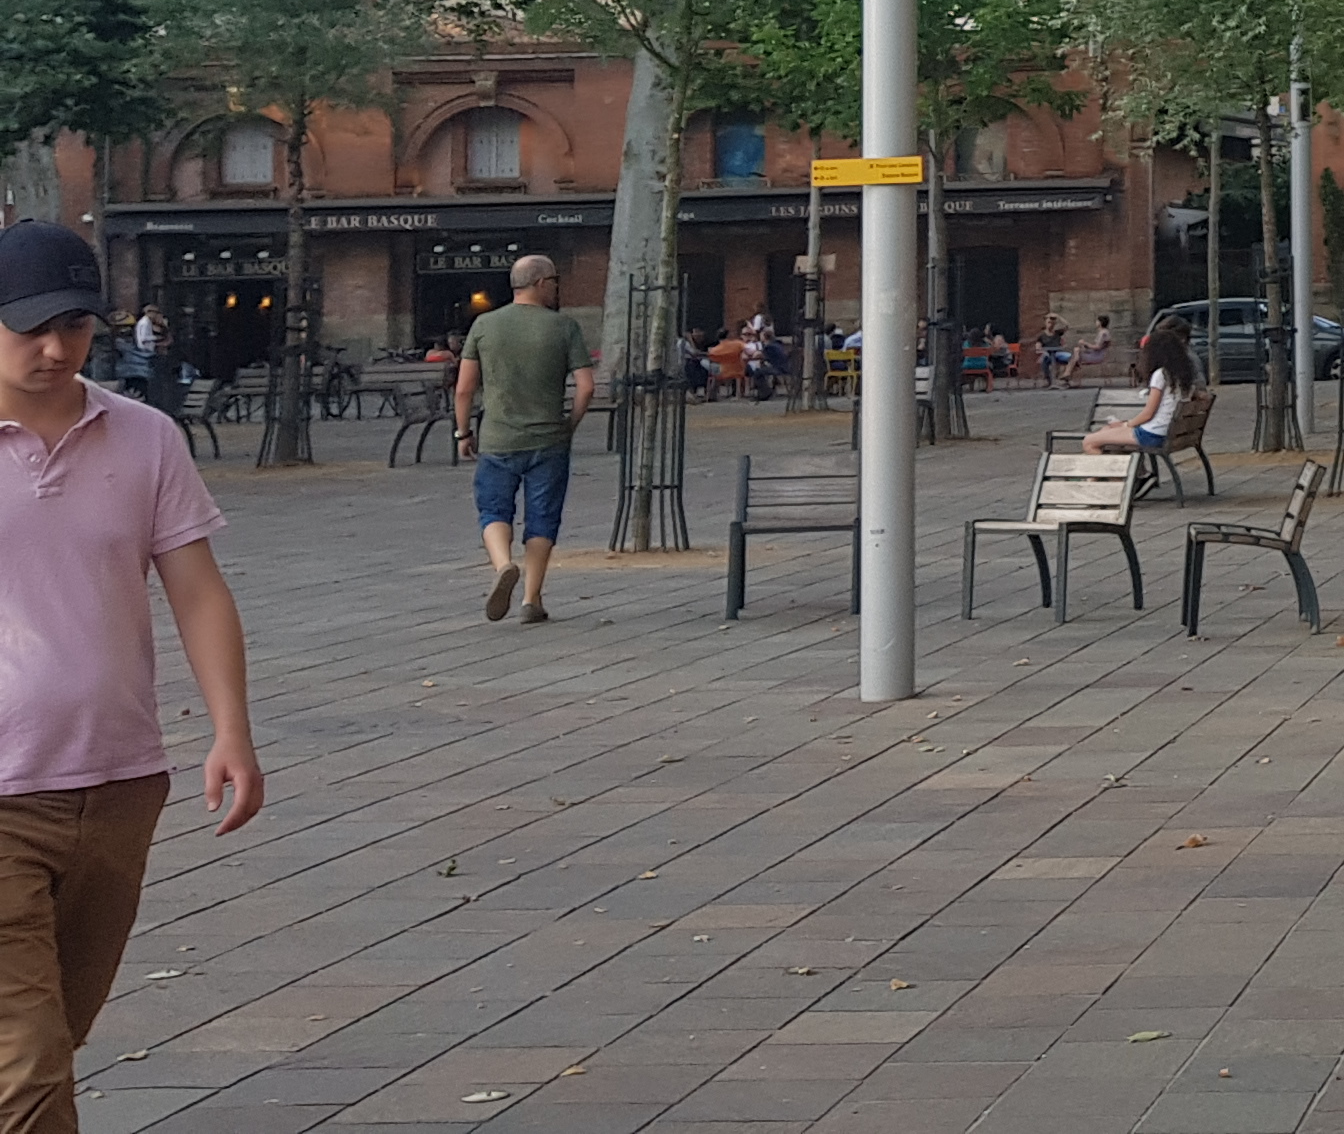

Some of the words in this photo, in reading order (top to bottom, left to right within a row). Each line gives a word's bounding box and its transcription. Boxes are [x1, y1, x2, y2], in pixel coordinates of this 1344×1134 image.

[771, 206, 795, 216] LES
[327, 215, 361, 228] BAR
[367, 214, 438, 230] BASQUE
[538, 213, 583, 223] Cocktail
[243, 261, 290, 275] BASQU
[430, 257, 446, 268] LE
[454, 256, 482, 268] BAR
[490, 255, 516, 267] BAS
